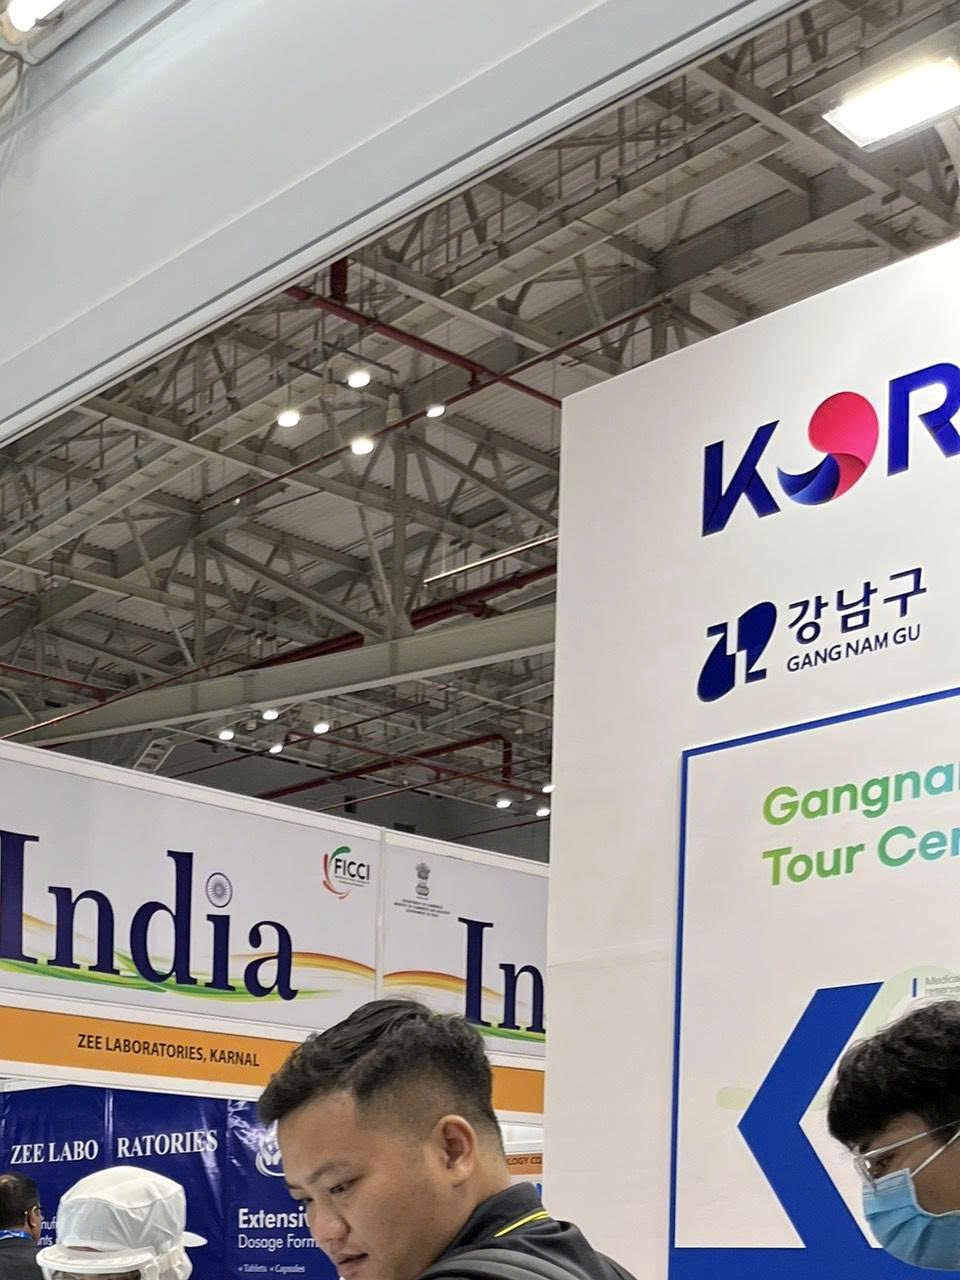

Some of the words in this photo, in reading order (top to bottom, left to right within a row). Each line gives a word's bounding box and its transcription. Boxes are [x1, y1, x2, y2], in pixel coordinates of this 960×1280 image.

[788, 567, 927, 645] 강남구
[787, 645, 842, 673] GANG
[845, 632, 889, 658] NAM
[893, 623, 921, 645] GU
[763, 762, 960, 826] Gangna
[334, 858, 371, 880] FICCI
[762, 842, 865, 886] Tour
[77, 1034, 102, 1050] ZEE
[105, 1036, 207, 1063] LABORATORIES,
[209, 1049, 260, 1067] KARNAL
[10, 1143, 44, 1164] ZEE
[48, 1139, 99, 1162] LABO
[116, 1130, 218, 1158] RATORIES
[238, 1234, 284, 1252] Dosage
